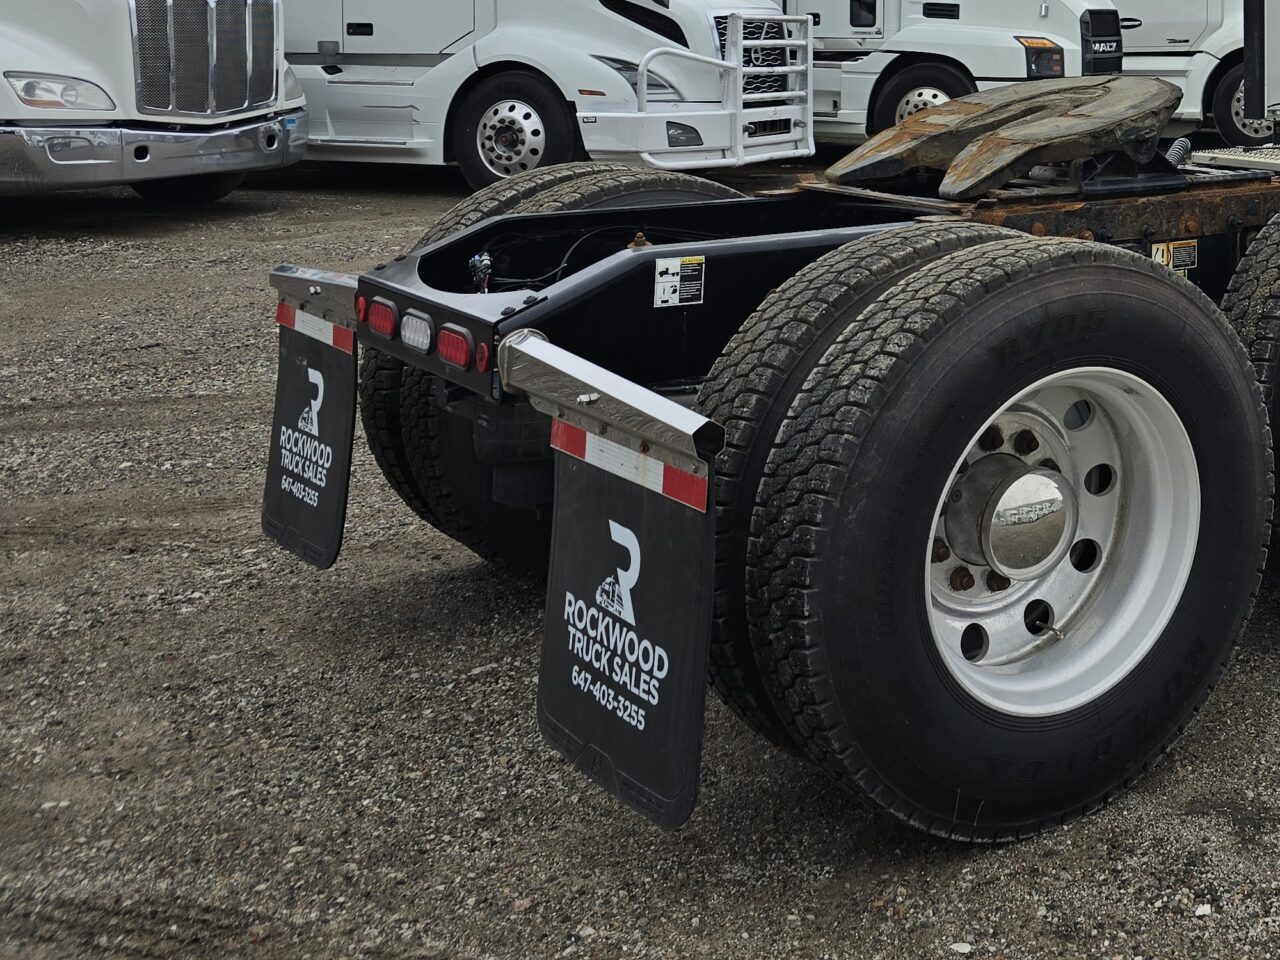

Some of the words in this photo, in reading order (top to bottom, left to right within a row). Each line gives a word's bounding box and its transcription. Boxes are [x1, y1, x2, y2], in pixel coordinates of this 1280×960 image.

[280, 425, 332, 469] ROCKWOOD
[281, 448, 305, 477] TRUCK
[303, 460, 327, 488] SALES
[281, 475, 319, 507] 647-403-3255
[564, 591, 669, 680] ROCKWOOD
[568, 625, 611, 677] TRUCK
[612, 655, 660, 706] SALES
[571, 665, 646, 731] 647-403-3255
